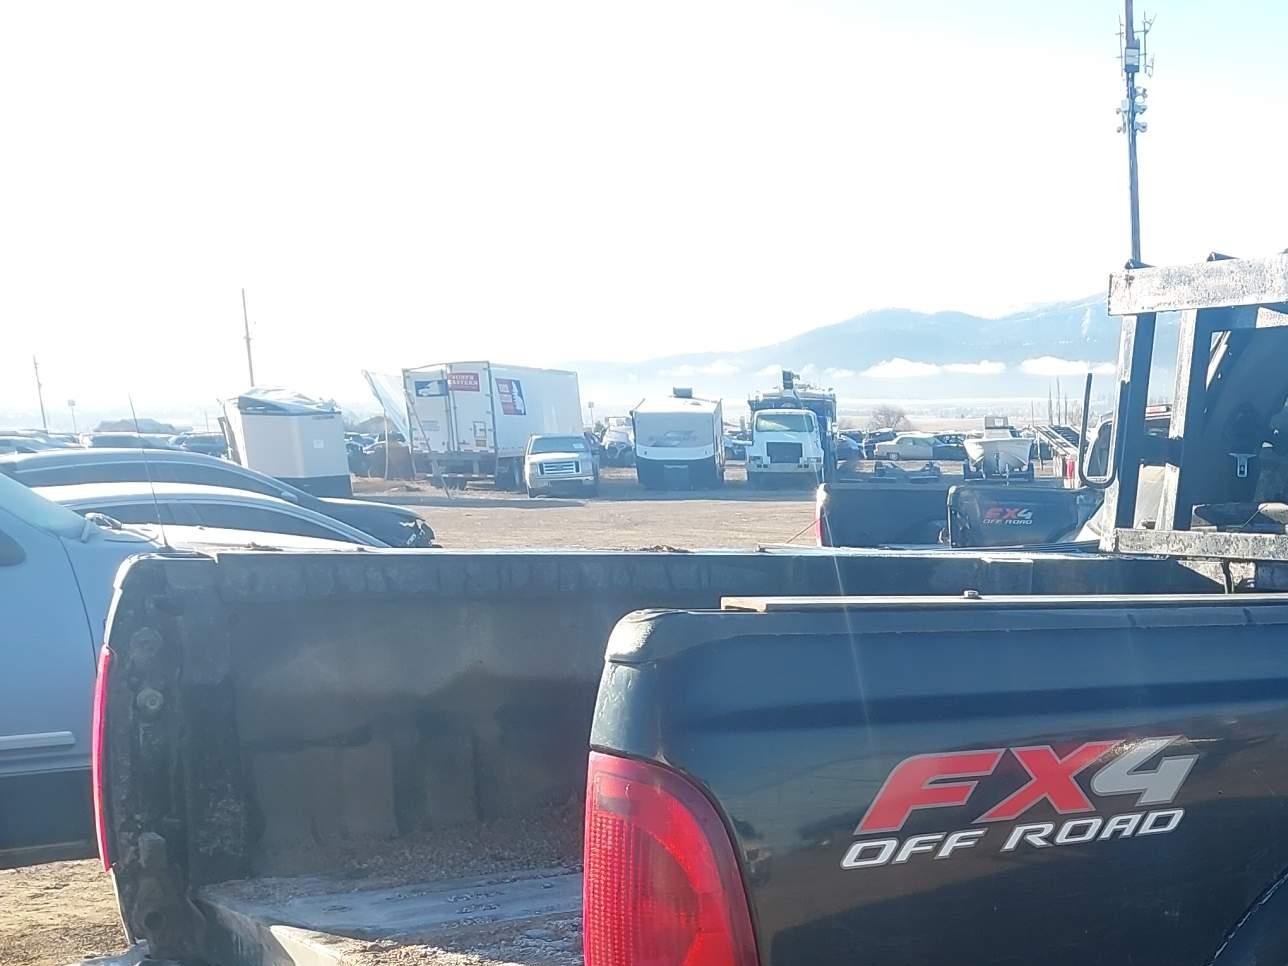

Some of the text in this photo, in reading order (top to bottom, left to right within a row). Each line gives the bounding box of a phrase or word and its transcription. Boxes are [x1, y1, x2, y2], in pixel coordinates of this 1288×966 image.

[983, 506, 1033, 520] FX4
[853, 734, 1200, 835] FX4
[840, 807, 1185, 870] OFF ROAD
